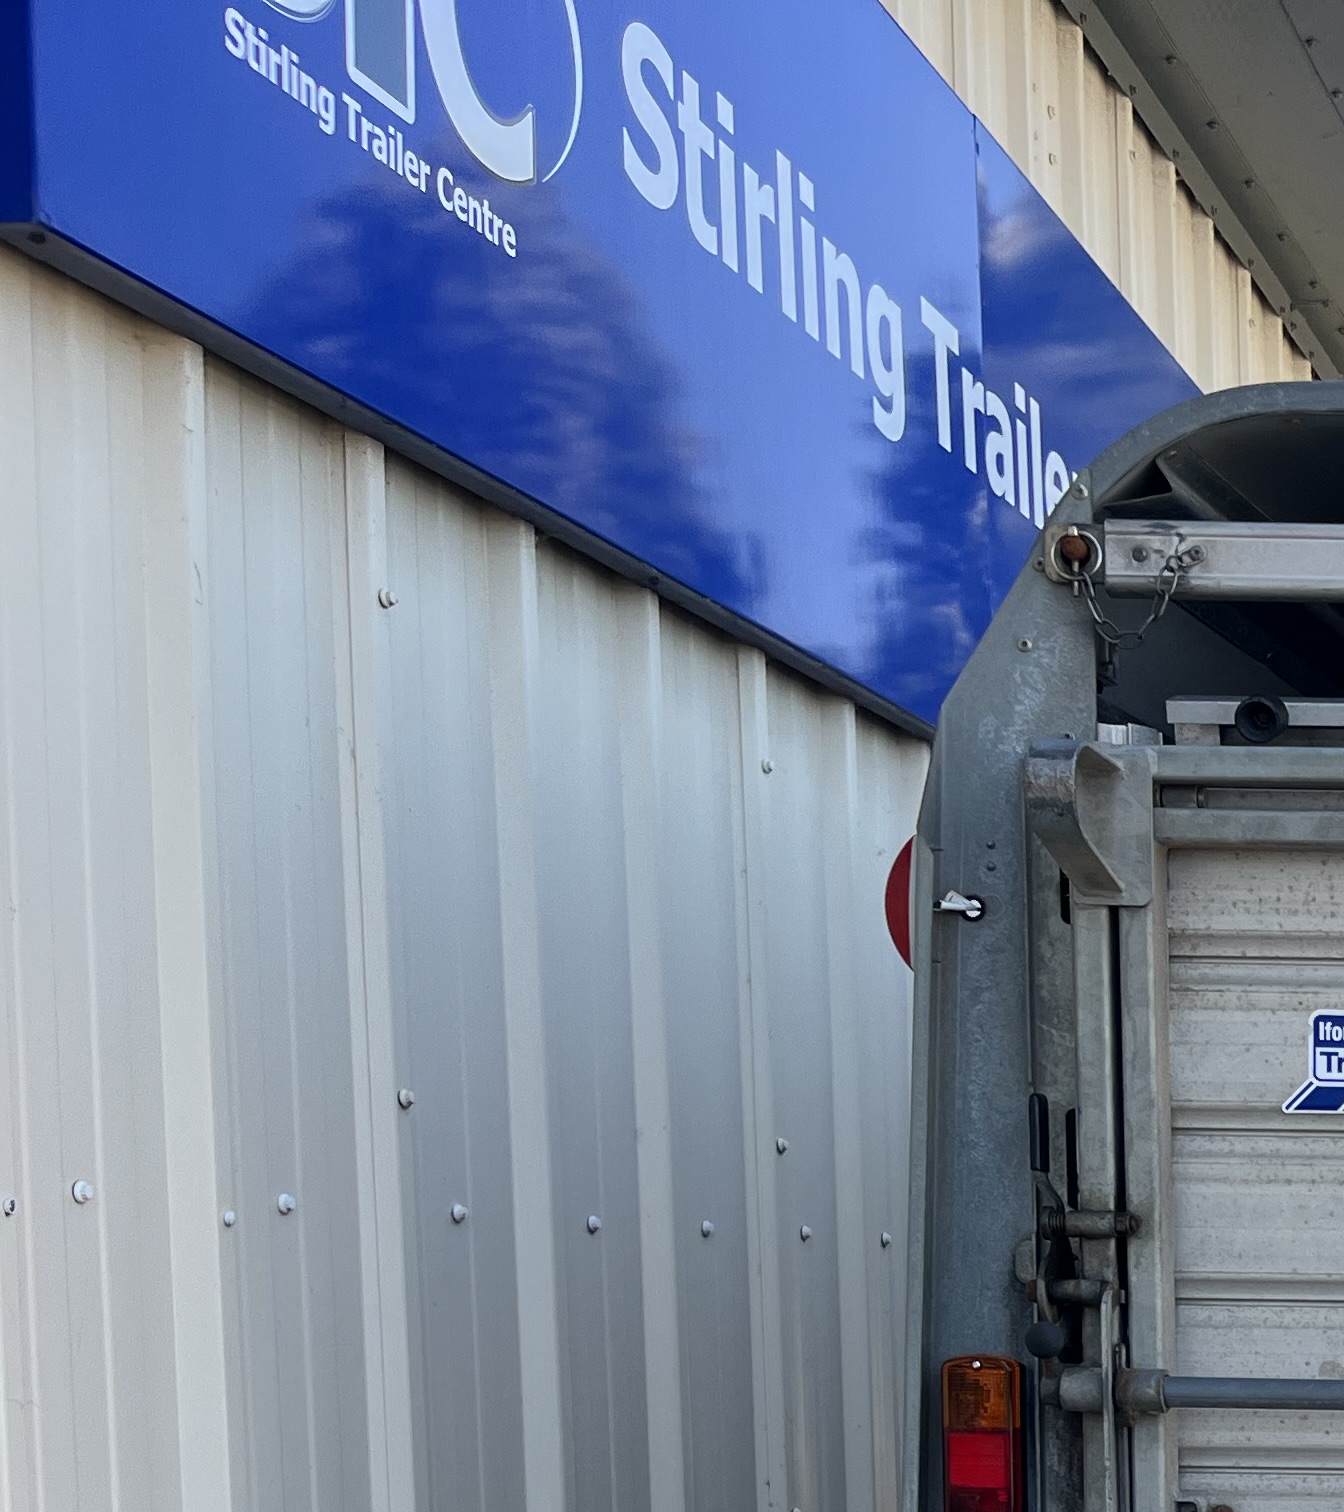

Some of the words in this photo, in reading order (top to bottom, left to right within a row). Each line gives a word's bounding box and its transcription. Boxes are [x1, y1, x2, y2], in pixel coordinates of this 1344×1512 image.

[224, 8, 335, 135] Stirling
[342, 92, 431, 193] Trailer
[437, 167, 516, 257] Centre
[622, 22, 905, 441] Stirling
[920, 295, 1078, 530] Traile
